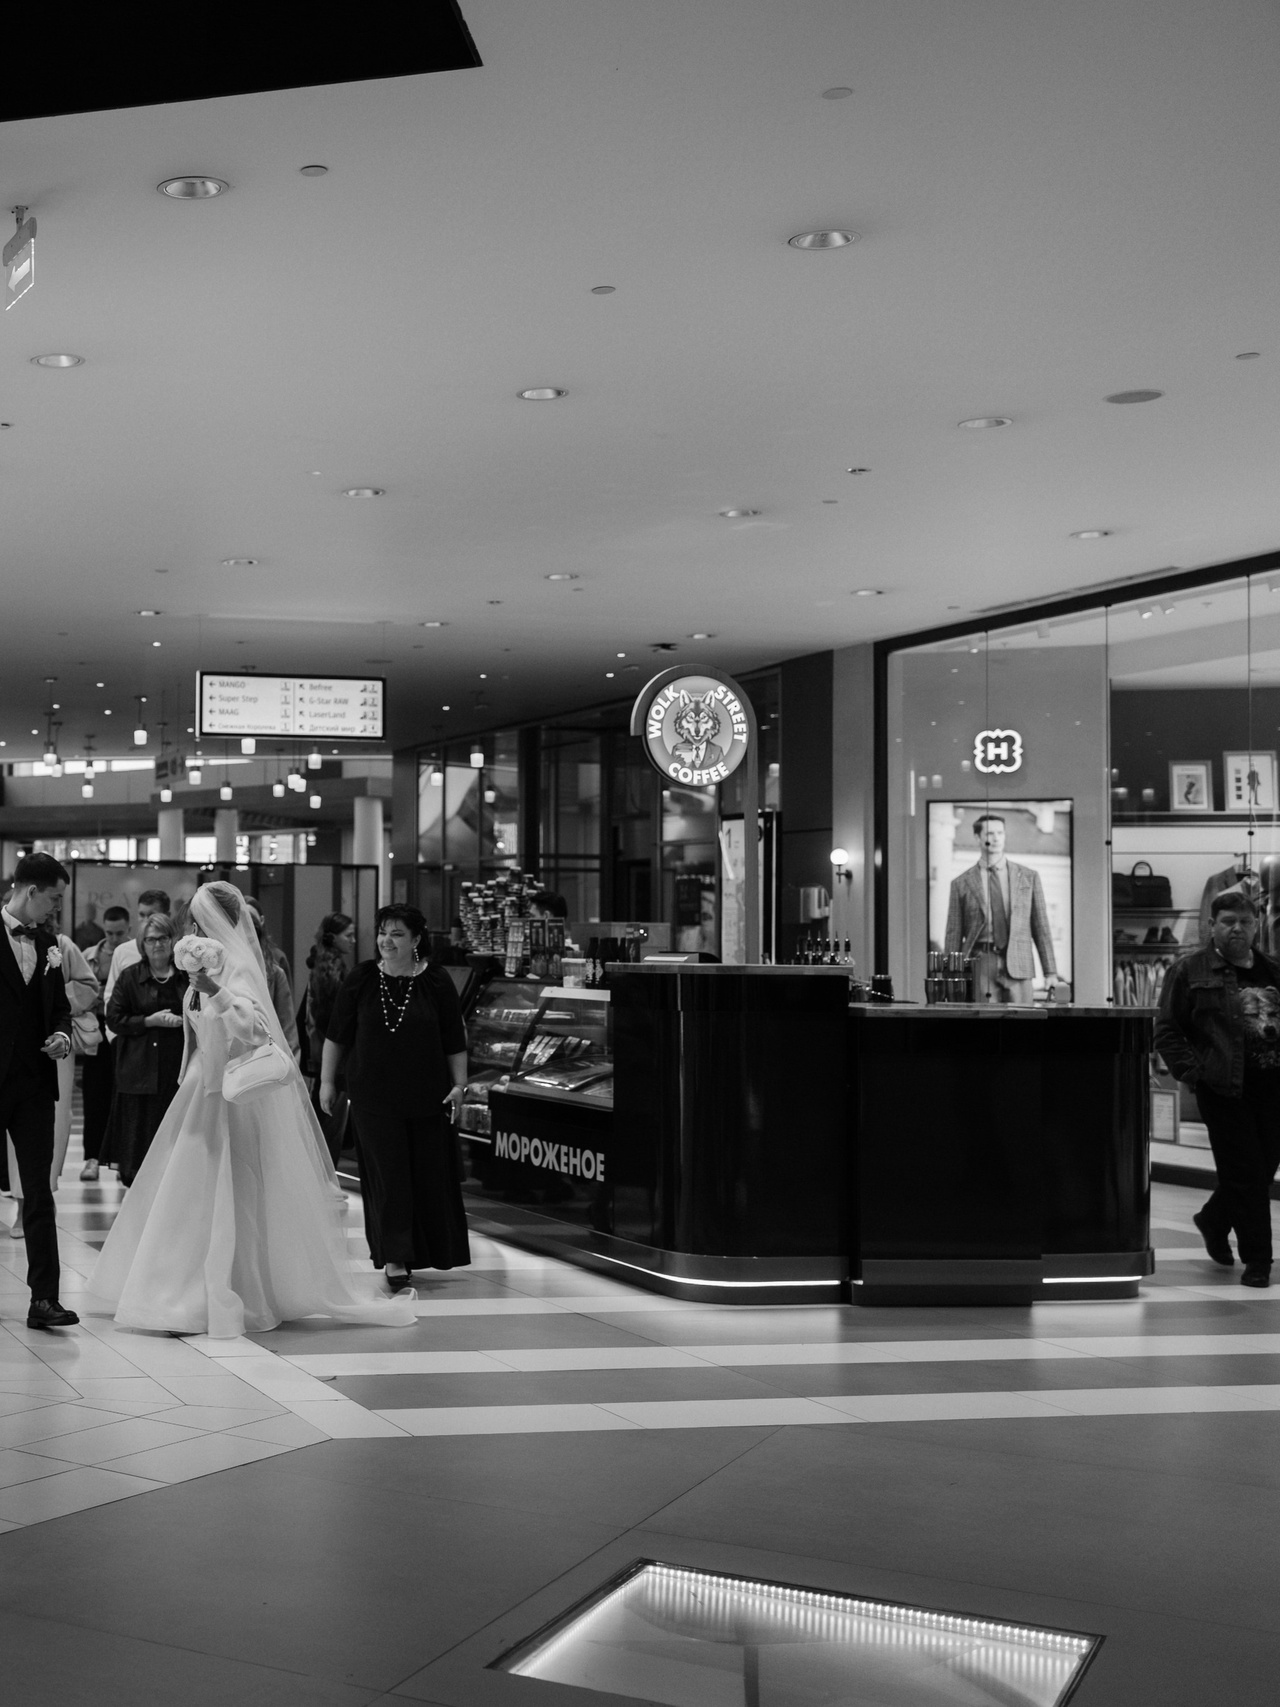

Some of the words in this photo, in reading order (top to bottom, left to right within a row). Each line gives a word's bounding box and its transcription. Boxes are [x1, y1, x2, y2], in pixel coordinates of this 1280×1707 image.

[219, 681, 245, 689] MANGO
[648, 685, 680, 739] WOLK
[714, 686, 747, 743] STREET
[668, 762, 729, 784] COFFEE
[495, 1131, 605, 1182] МОРОЖЕНОЕ
